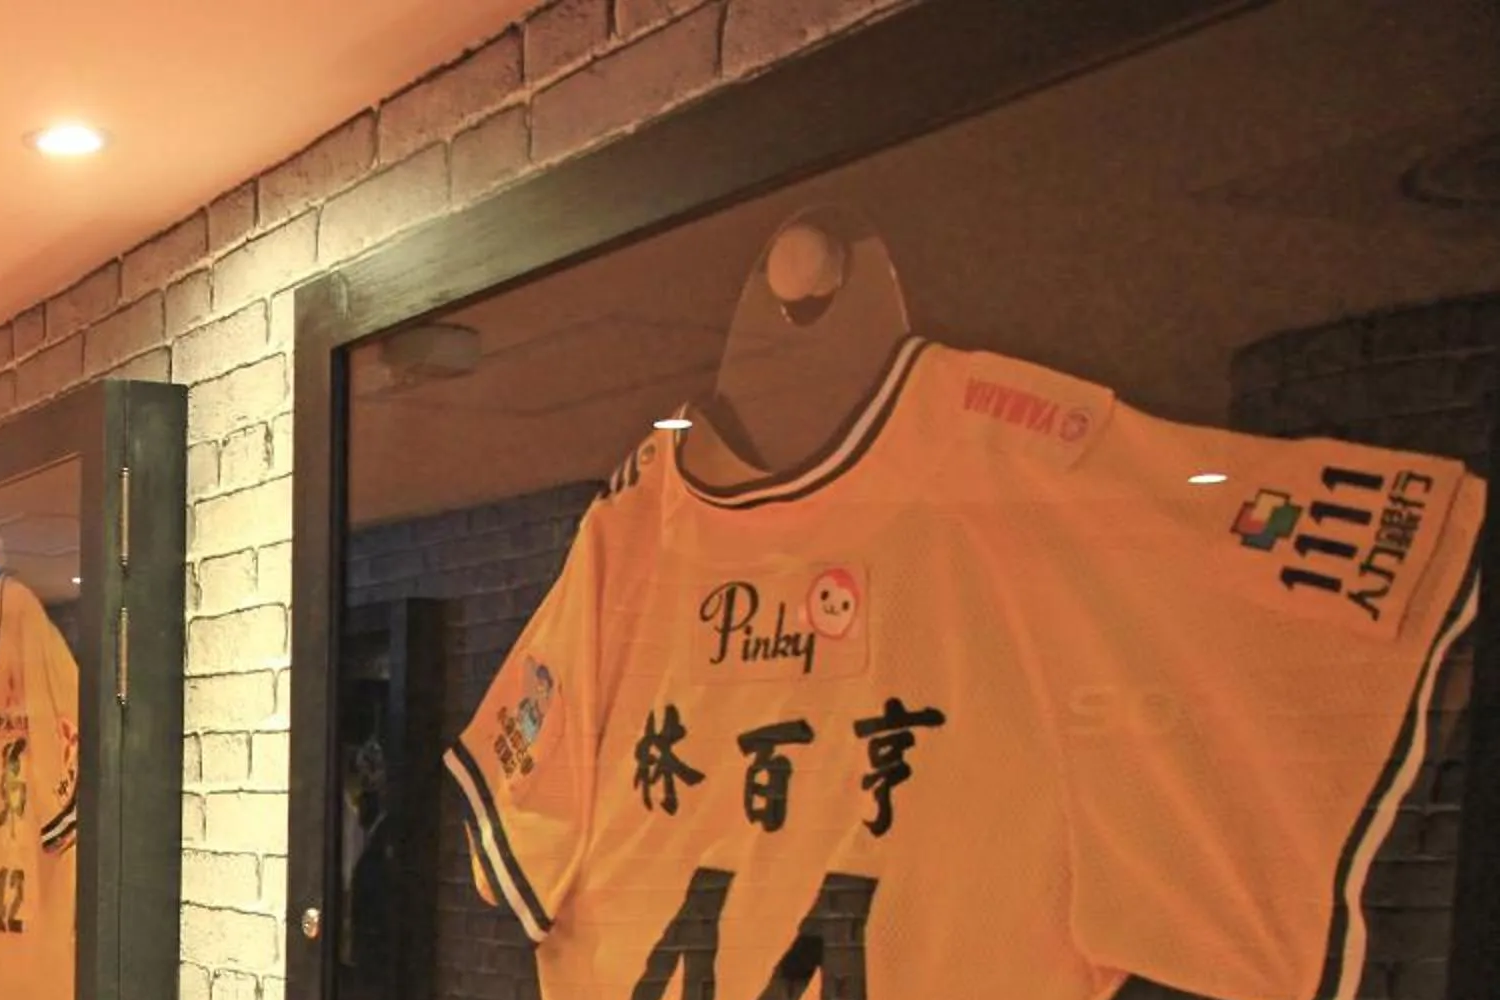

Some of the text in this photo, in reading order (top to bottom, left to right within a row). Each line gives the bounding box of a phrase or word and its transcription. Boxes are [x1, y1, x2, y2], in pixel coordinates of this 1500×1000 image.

[1279, 465, 1385, 593] 1111
[1346, 469, 1434, 622] 人力銀行
[699, 579, 818, 674] Pinky
[633, 697, 946, 838] 林百亨
